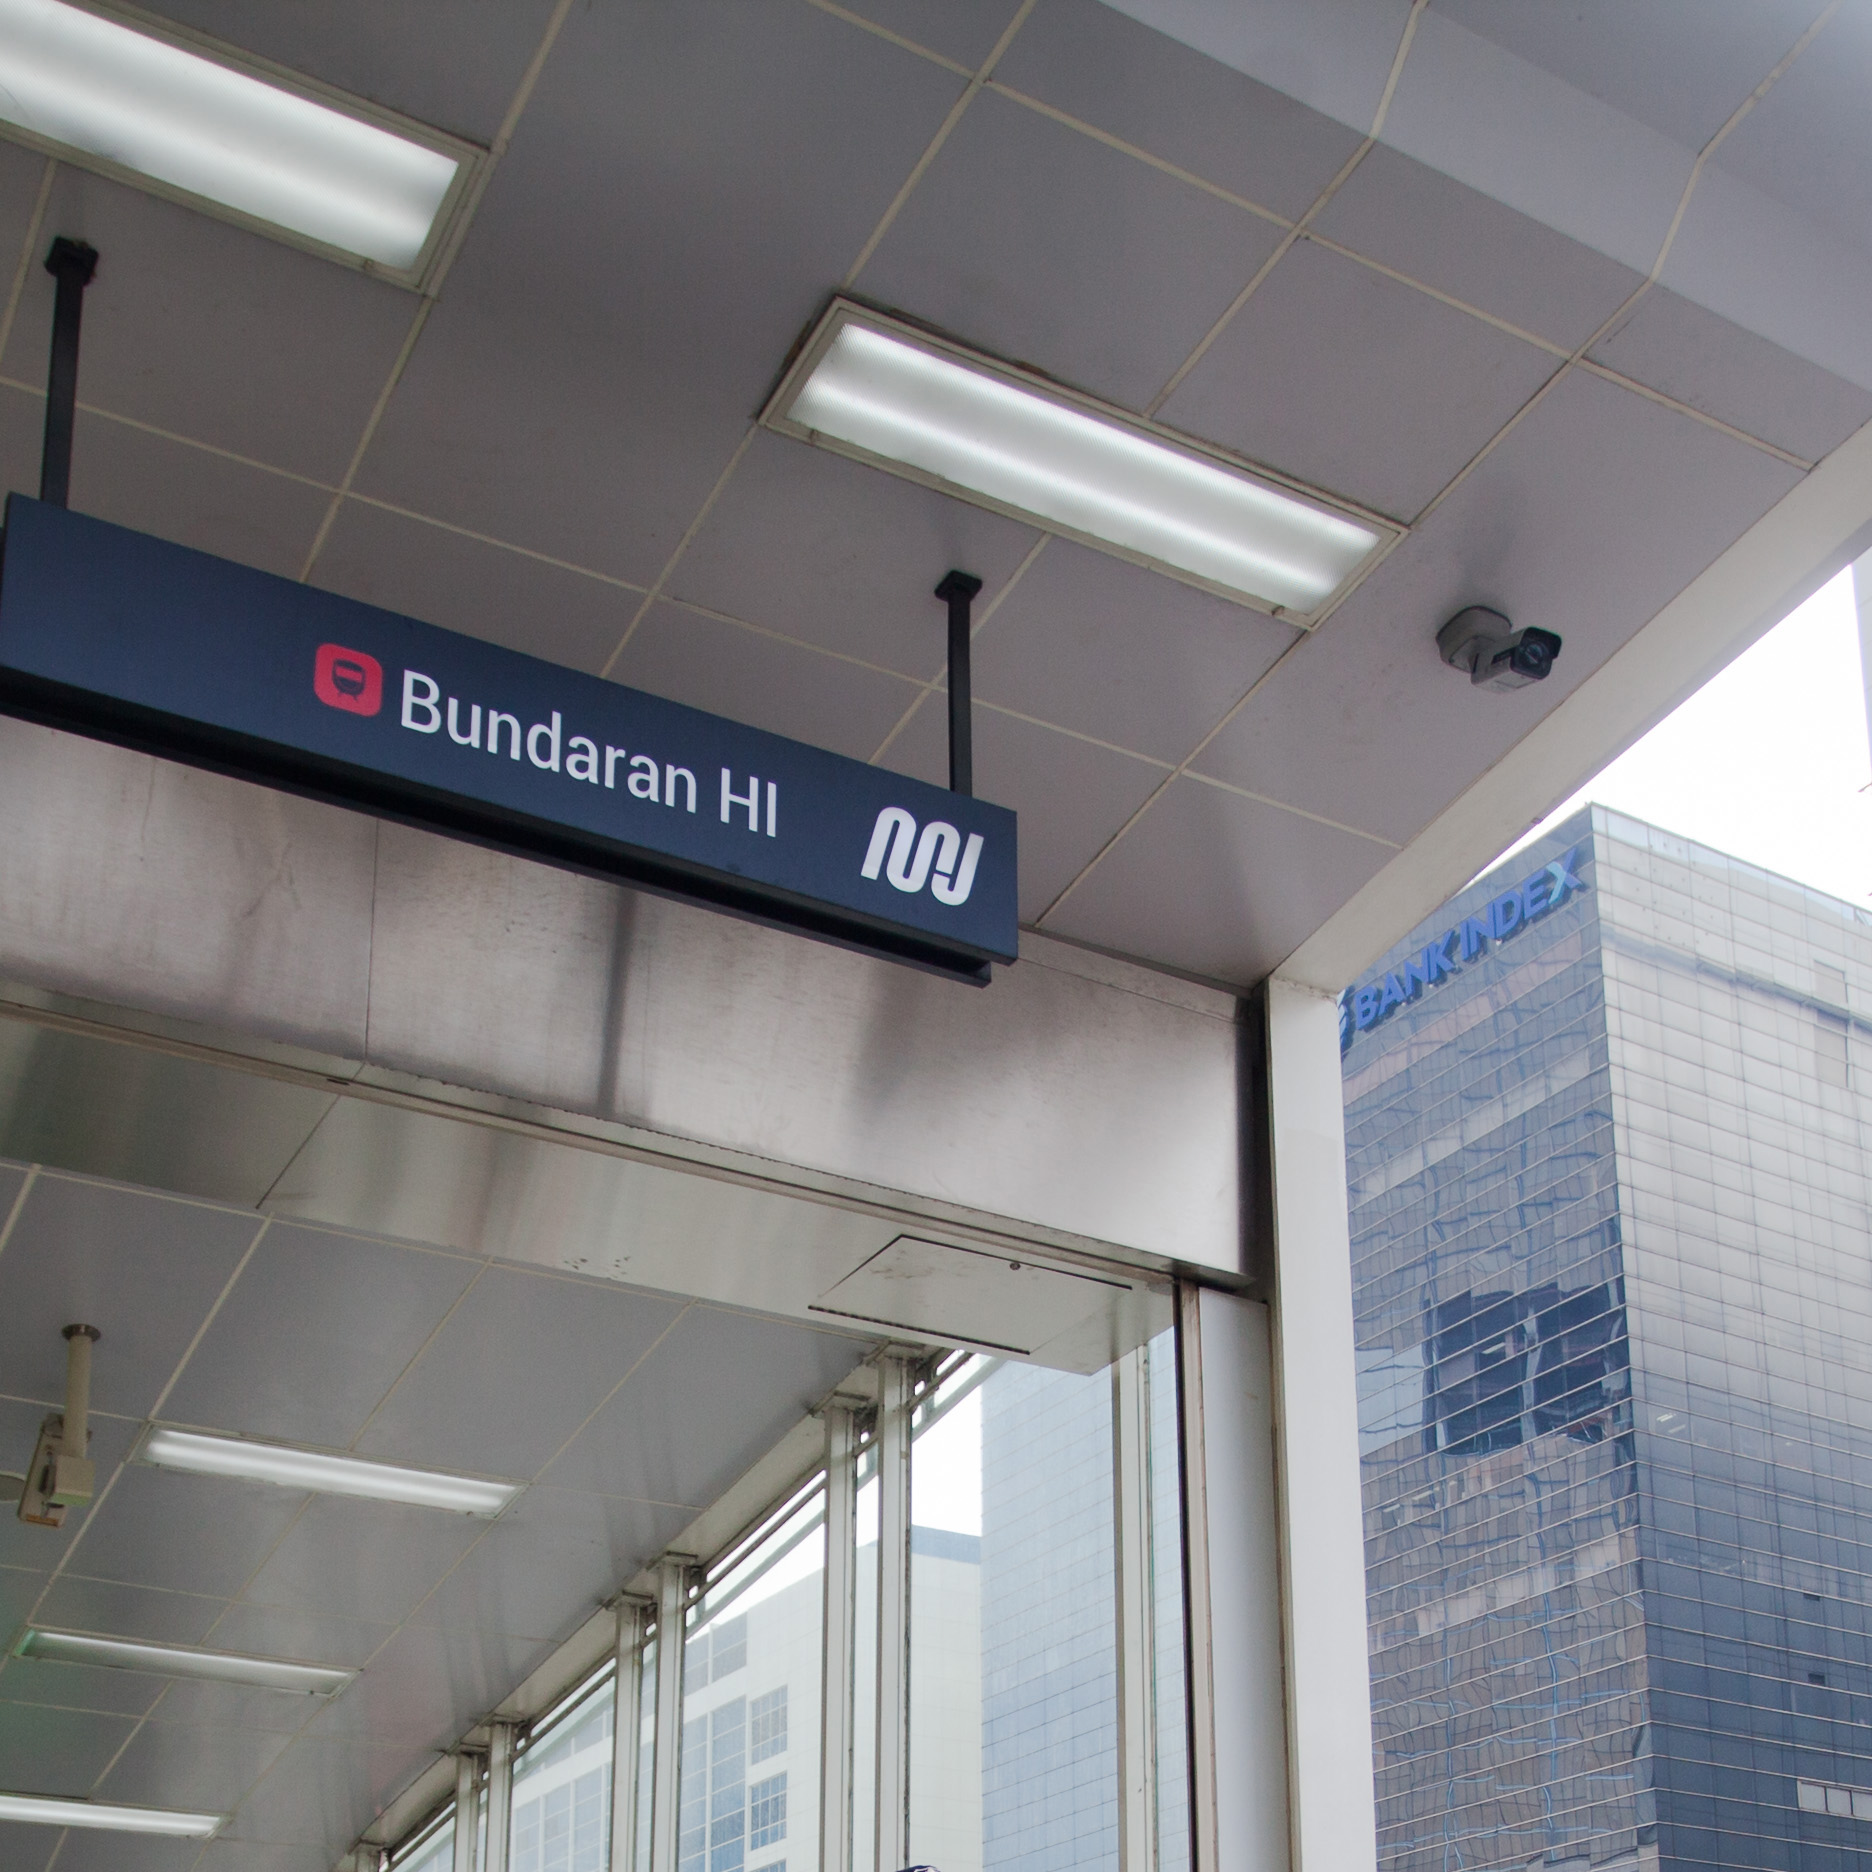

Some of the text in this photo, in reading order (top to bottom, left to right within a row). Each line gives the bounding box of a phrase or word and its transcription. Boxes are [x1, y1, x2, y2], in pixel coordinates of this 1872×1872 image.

[401, 669, 778, 838] Bundaran HI
[1354, 848, 1582, 1030] BANK INDEX
